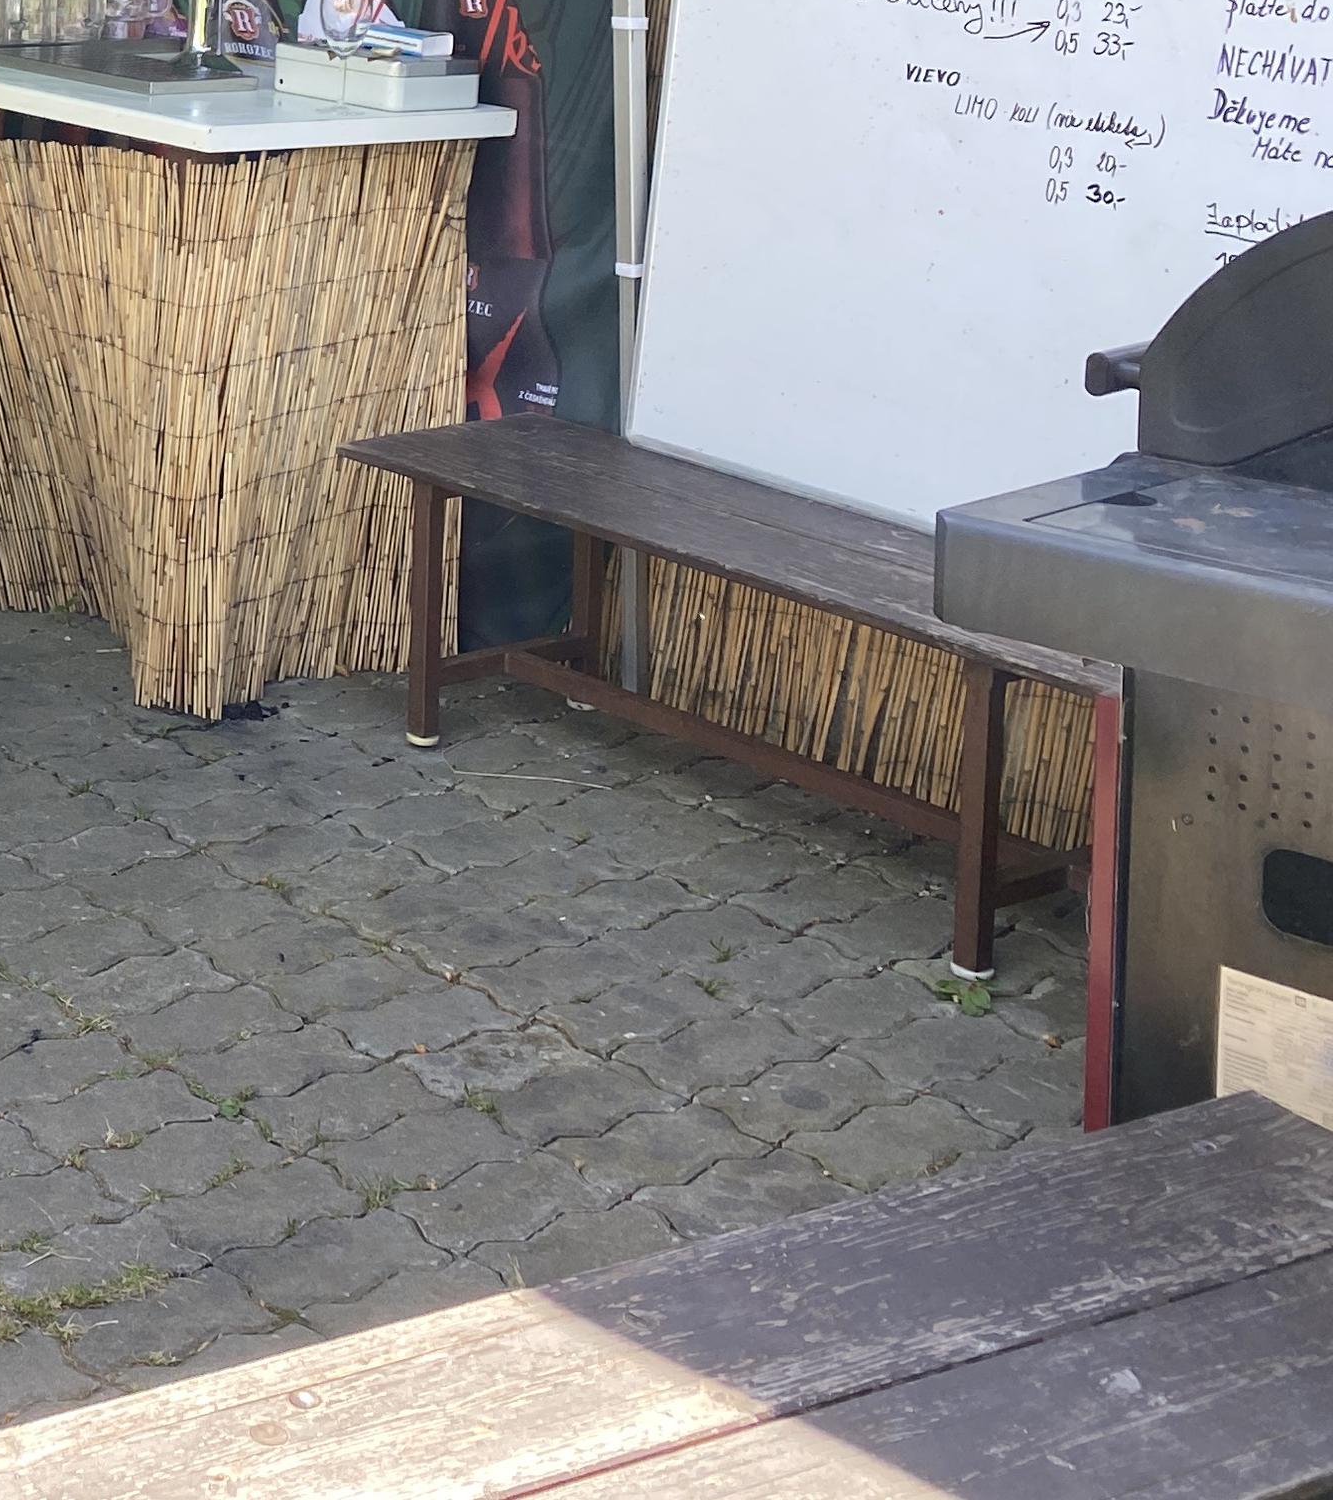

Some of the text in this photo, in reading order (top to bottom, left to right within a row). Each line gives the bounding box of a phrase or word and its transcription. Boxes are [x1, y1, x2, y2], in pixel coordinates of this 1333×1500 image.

[234, 9, 255, 33] R
[1054, 29, 1080, 56] 0,5
[1048, 145, 1074, 174] 0,3
[1045, 177, 1070, 206] 0,5
